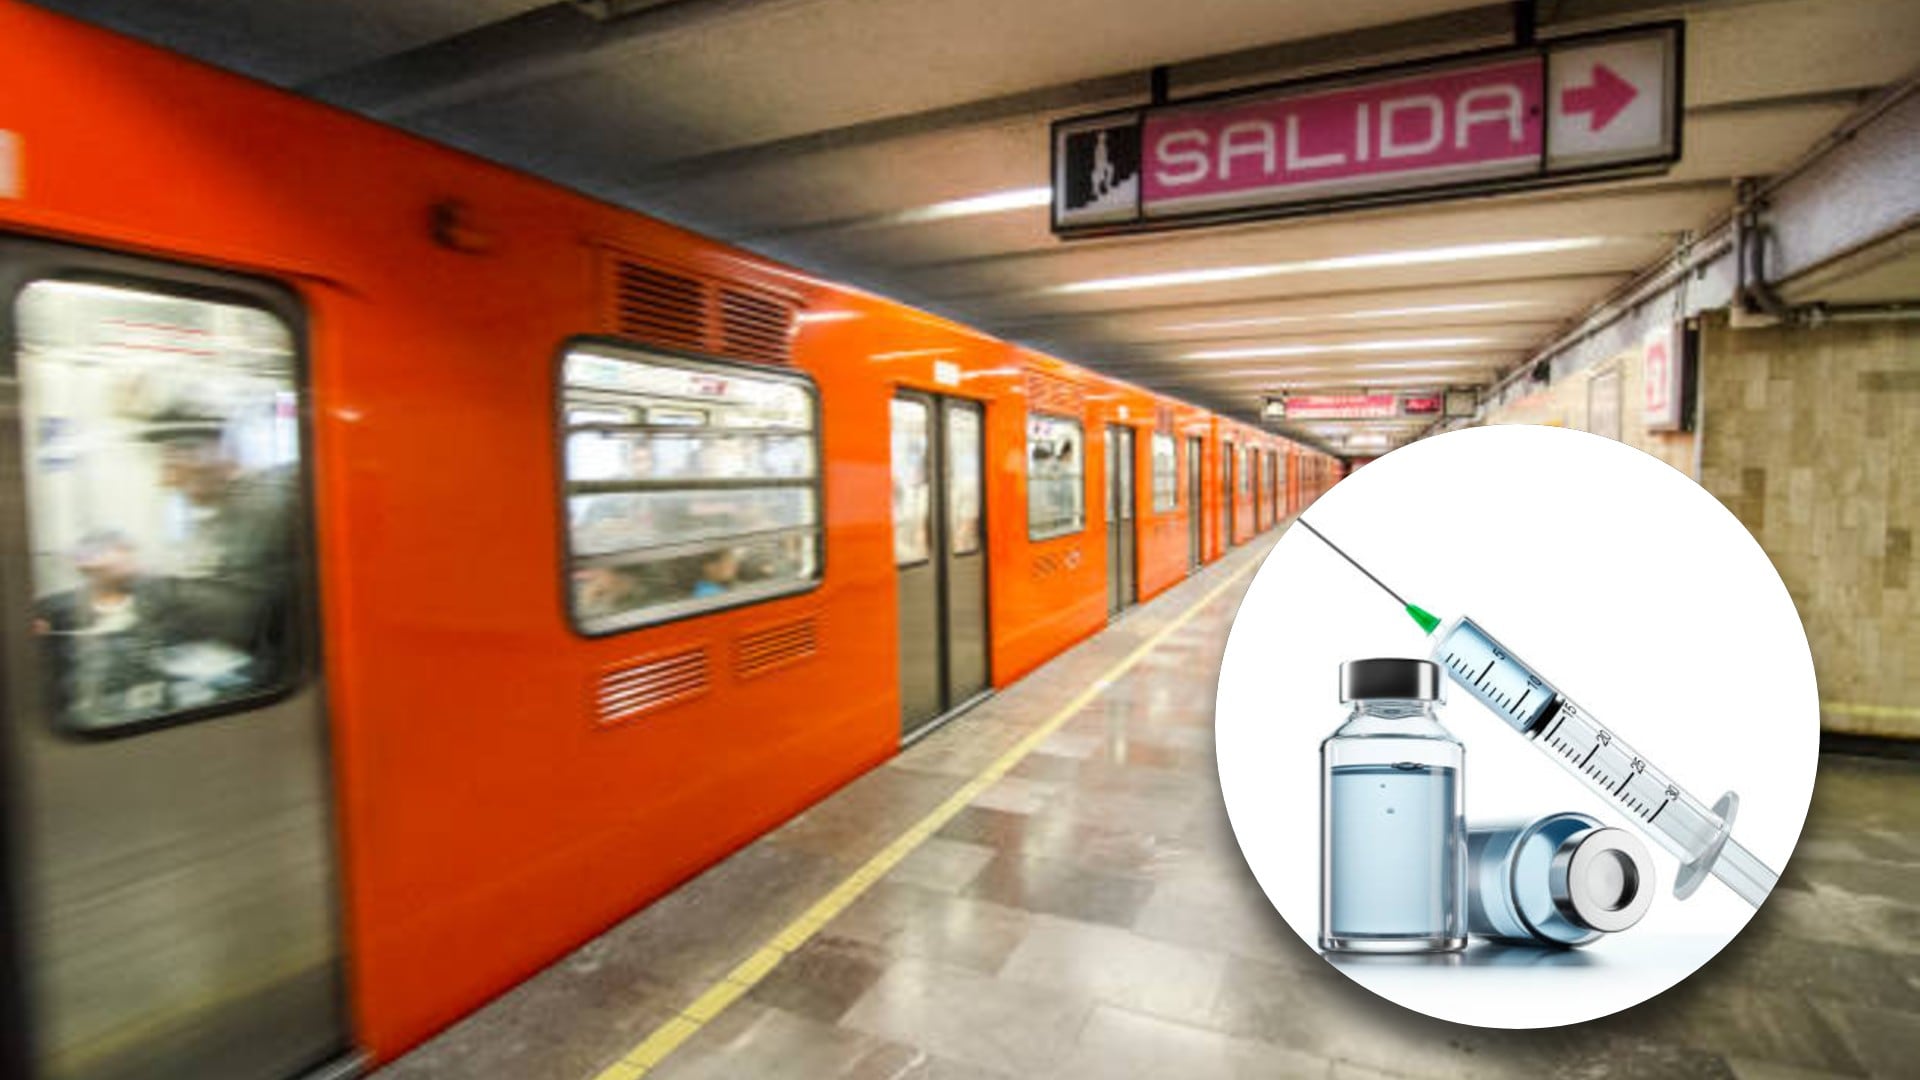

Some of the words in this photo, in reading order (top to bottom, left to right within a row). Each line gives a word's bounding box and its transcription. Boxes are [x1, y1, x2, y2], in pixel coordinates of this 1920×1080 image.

[1154, 84, 1524, 186] SALIDA
[1493, 648, 1506, 660] 5
[1527, 674, 1542, 690] 10
[1562, 702, 1577, 718] 15
[1596, 730, 1611, 747] 20
[1630, 756, 1646, 774] 25
[1665, 784, 1680, 801] 30
